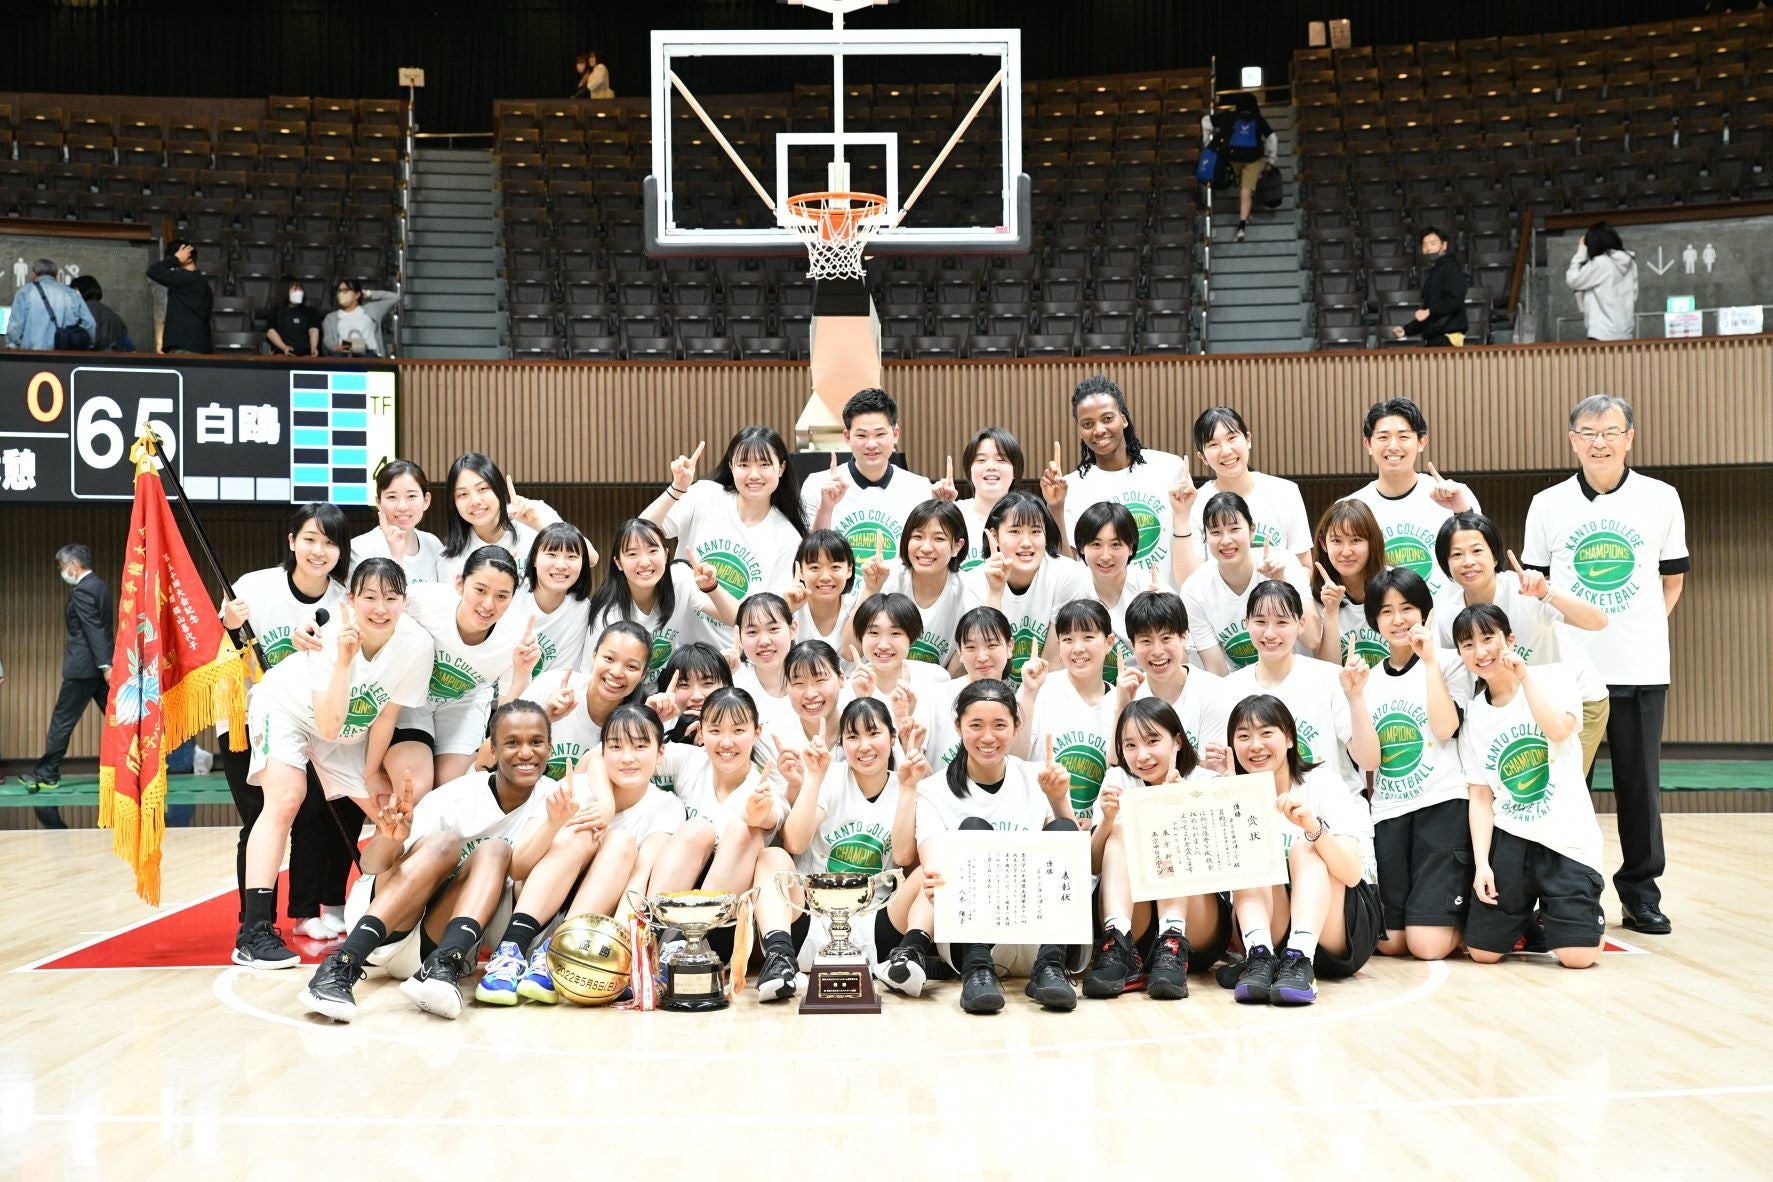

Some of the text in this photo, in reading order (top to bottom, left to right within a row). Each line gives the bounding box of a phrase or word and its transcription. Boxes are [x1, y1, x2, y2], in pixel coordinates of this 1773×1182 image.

[27, 371, 64, 423] 0
[370, 396, 392, 416] TF
[76, 396, 177, 471] 65
[1123, 490, 1166, 514] COLLEGE
[1565, 519, 1645, 551] KANTO COLLEGE
[696, 538, 762, 583] KANTO COLLEGE
[1580, 543, 1630, 561] CHAMPIONS
[1571, 581, 1641, 606] BASKETBALL
[1360, 628, 1389, 648] COLLE
[1391, 699, 1428, 728] COLLEGE
[1485, 732, 1509, 771] KANTO
[1502, 749, 1549, 777] CHAMPION
[825, 820, 863, 845] KANTO
[1247, 815, 1261, 842] 賞状
[1060, 870, 1071, 902] 表彰状
